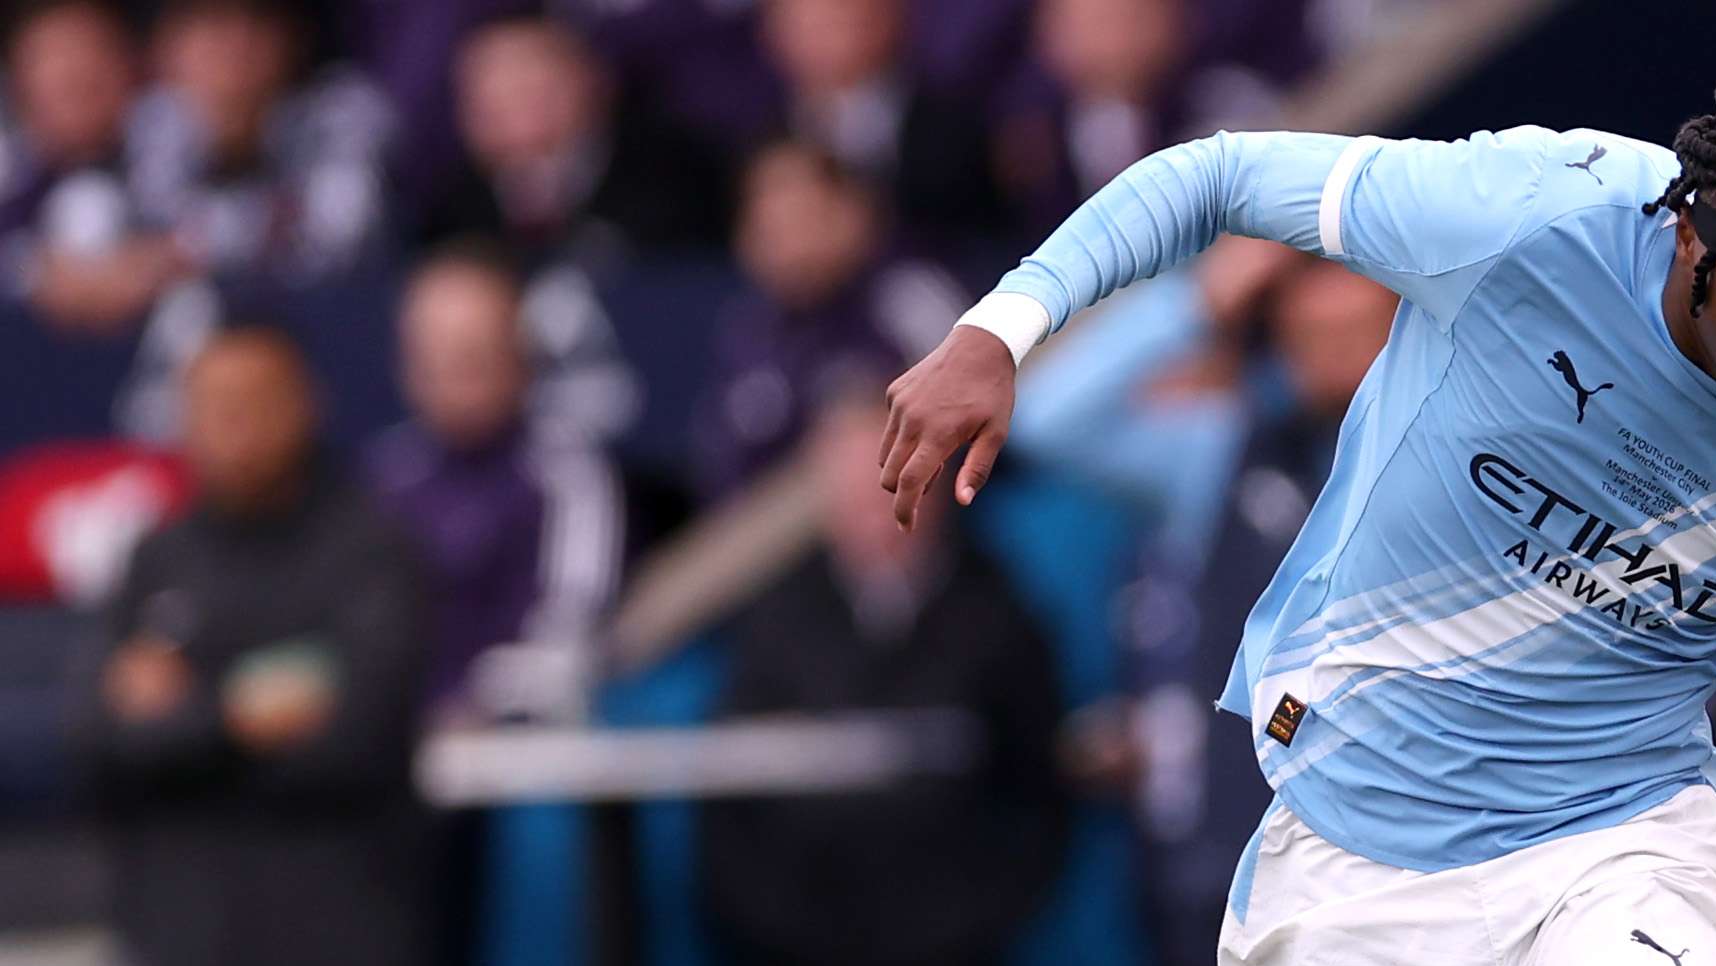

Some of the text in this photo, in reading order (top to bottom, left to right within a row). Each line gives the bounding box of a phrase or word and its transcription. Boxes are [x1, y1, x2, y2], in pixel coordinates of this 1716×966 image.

[1606, 459, 1661, 494] Manchester
[1618, 428, 1712, 491] FA YOUTH CUP FINAL
[1623, 444, 1695, 496] Manchester City
[1601, 481, 1679, 530] The Joie Stadium
[1630, 484, 1650, 501] May
[1653, 497, 1676, 514] 2026
[1503, 539, 1672, 632] AIRWAYS
